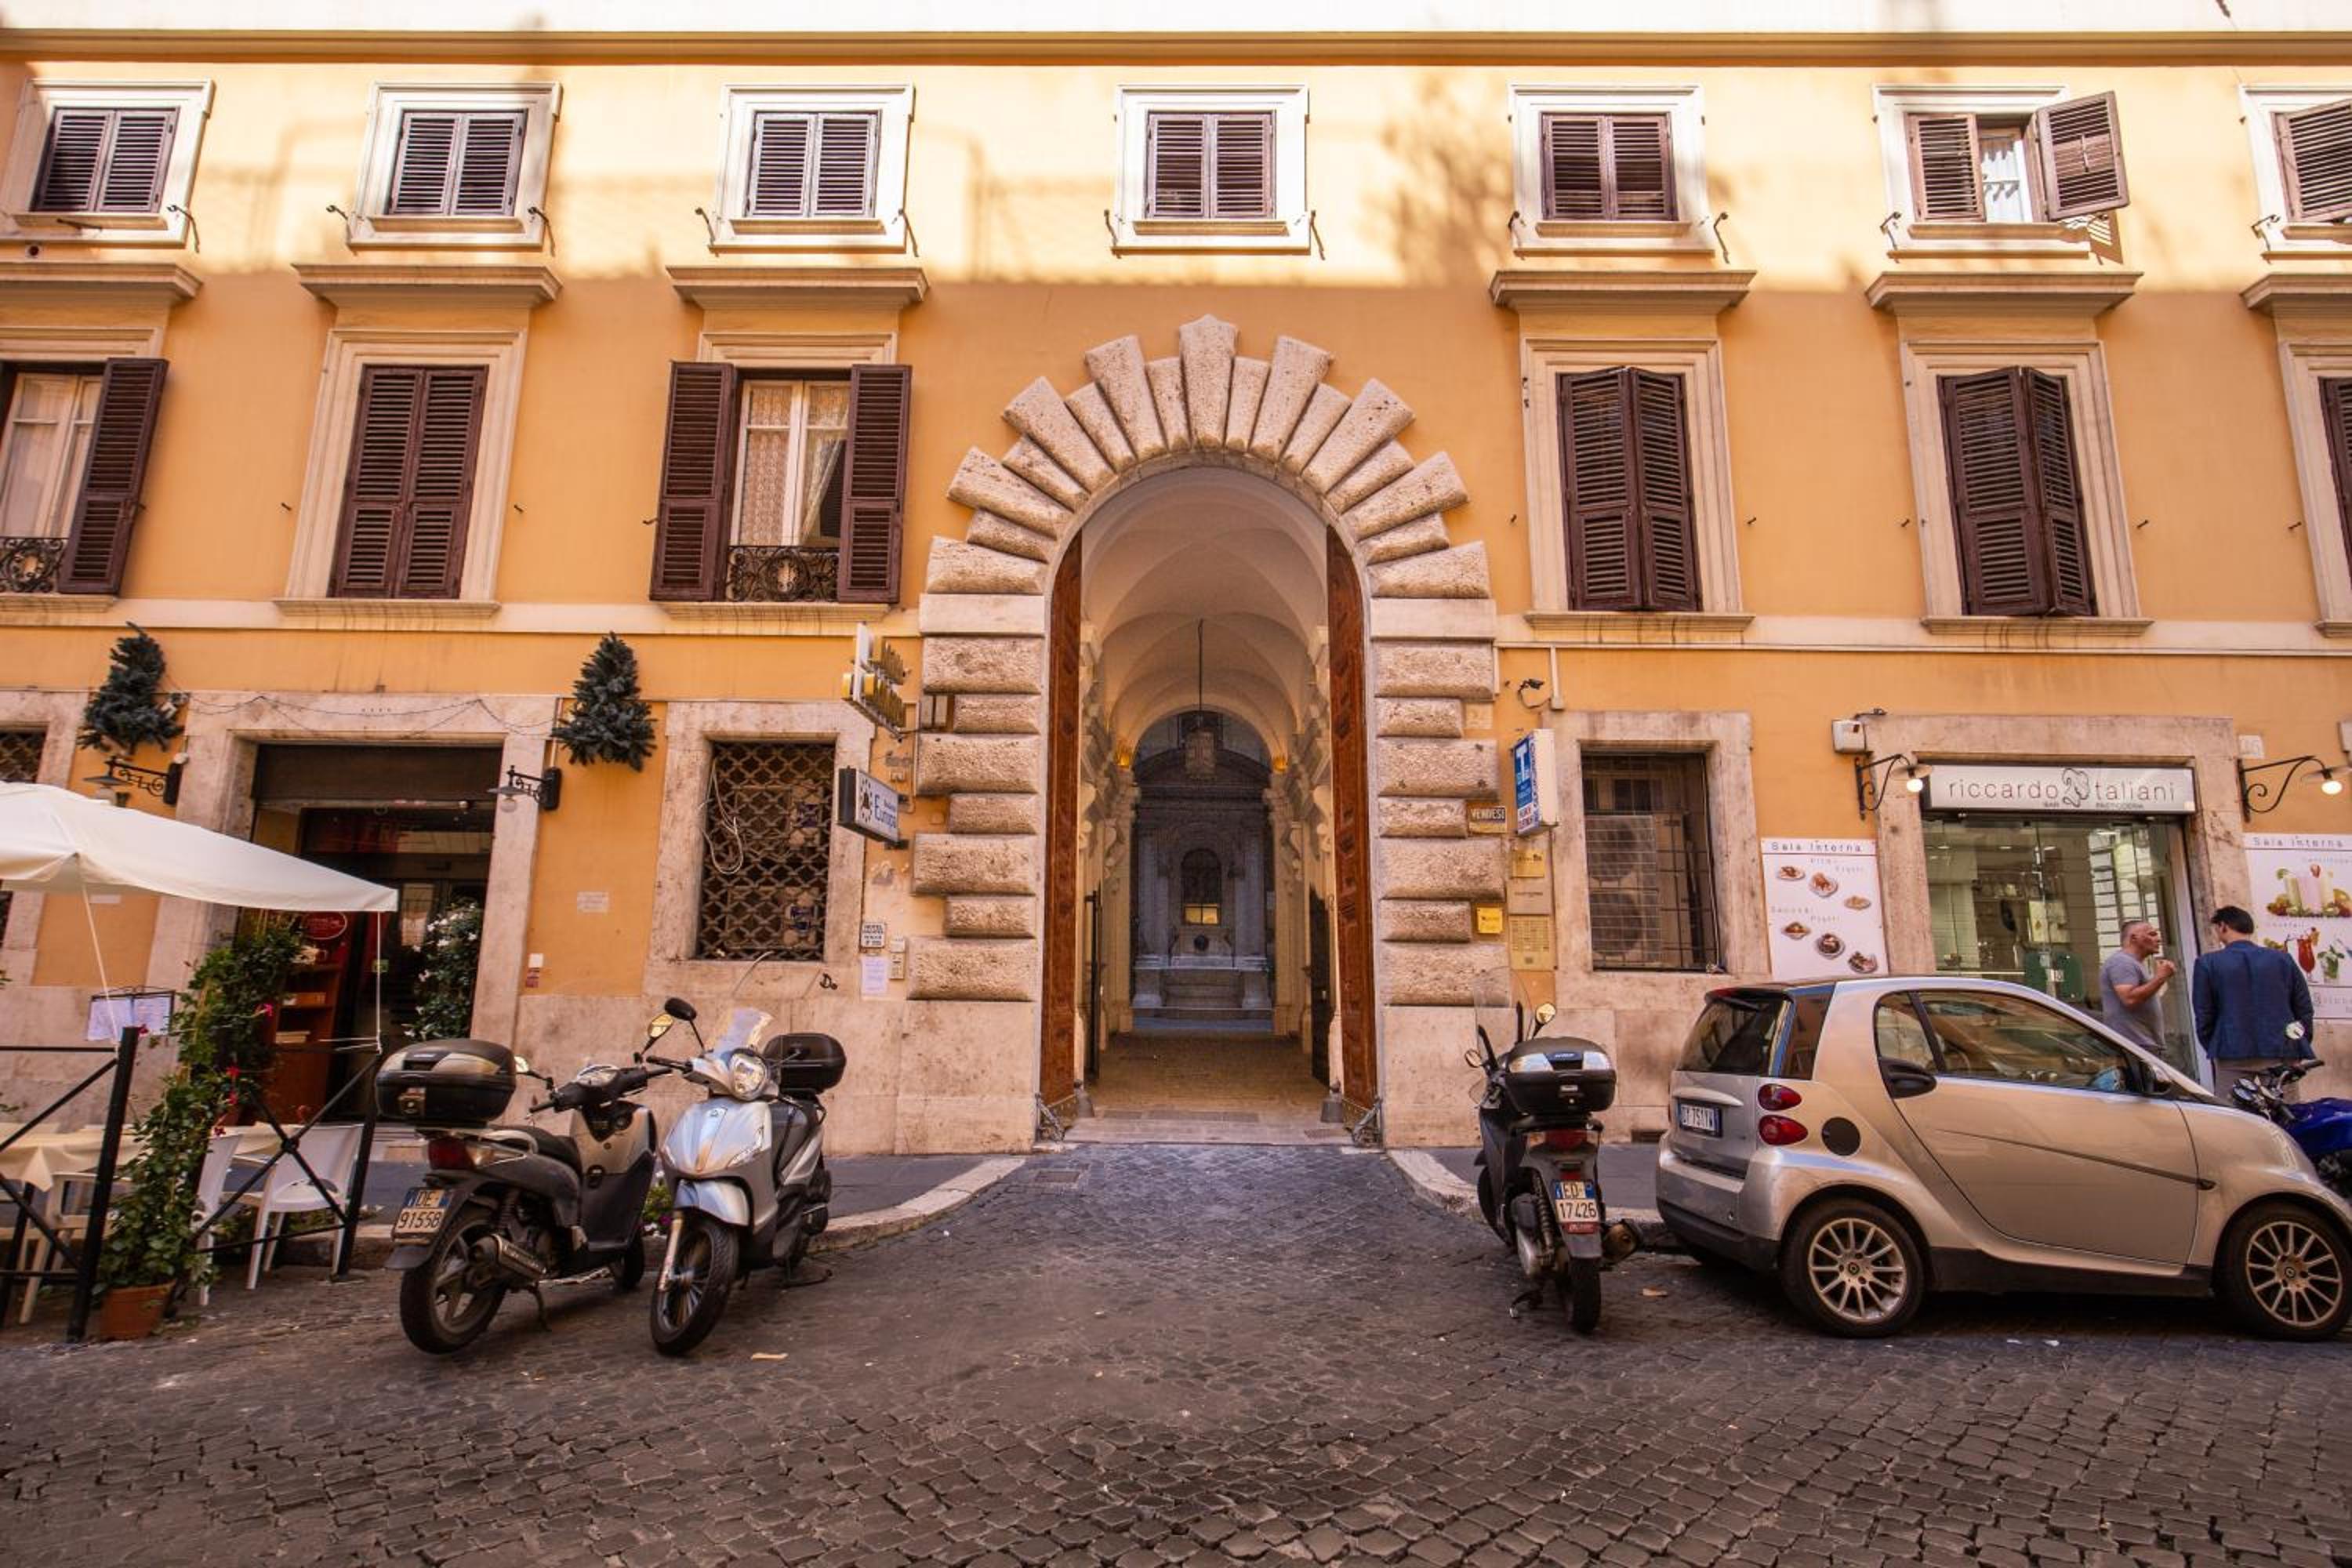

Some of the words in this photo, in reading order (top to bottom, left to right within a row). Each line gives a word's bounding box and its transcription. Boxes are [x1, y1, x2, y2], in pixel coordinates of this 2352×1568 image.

[1948, 779, 2059, 799] riccardo
[1471, 808, 1504, 820] VENDESI
[1559, 1201, 1597, 1218] 17426
[397, 1211, 442, 1229] 91558
